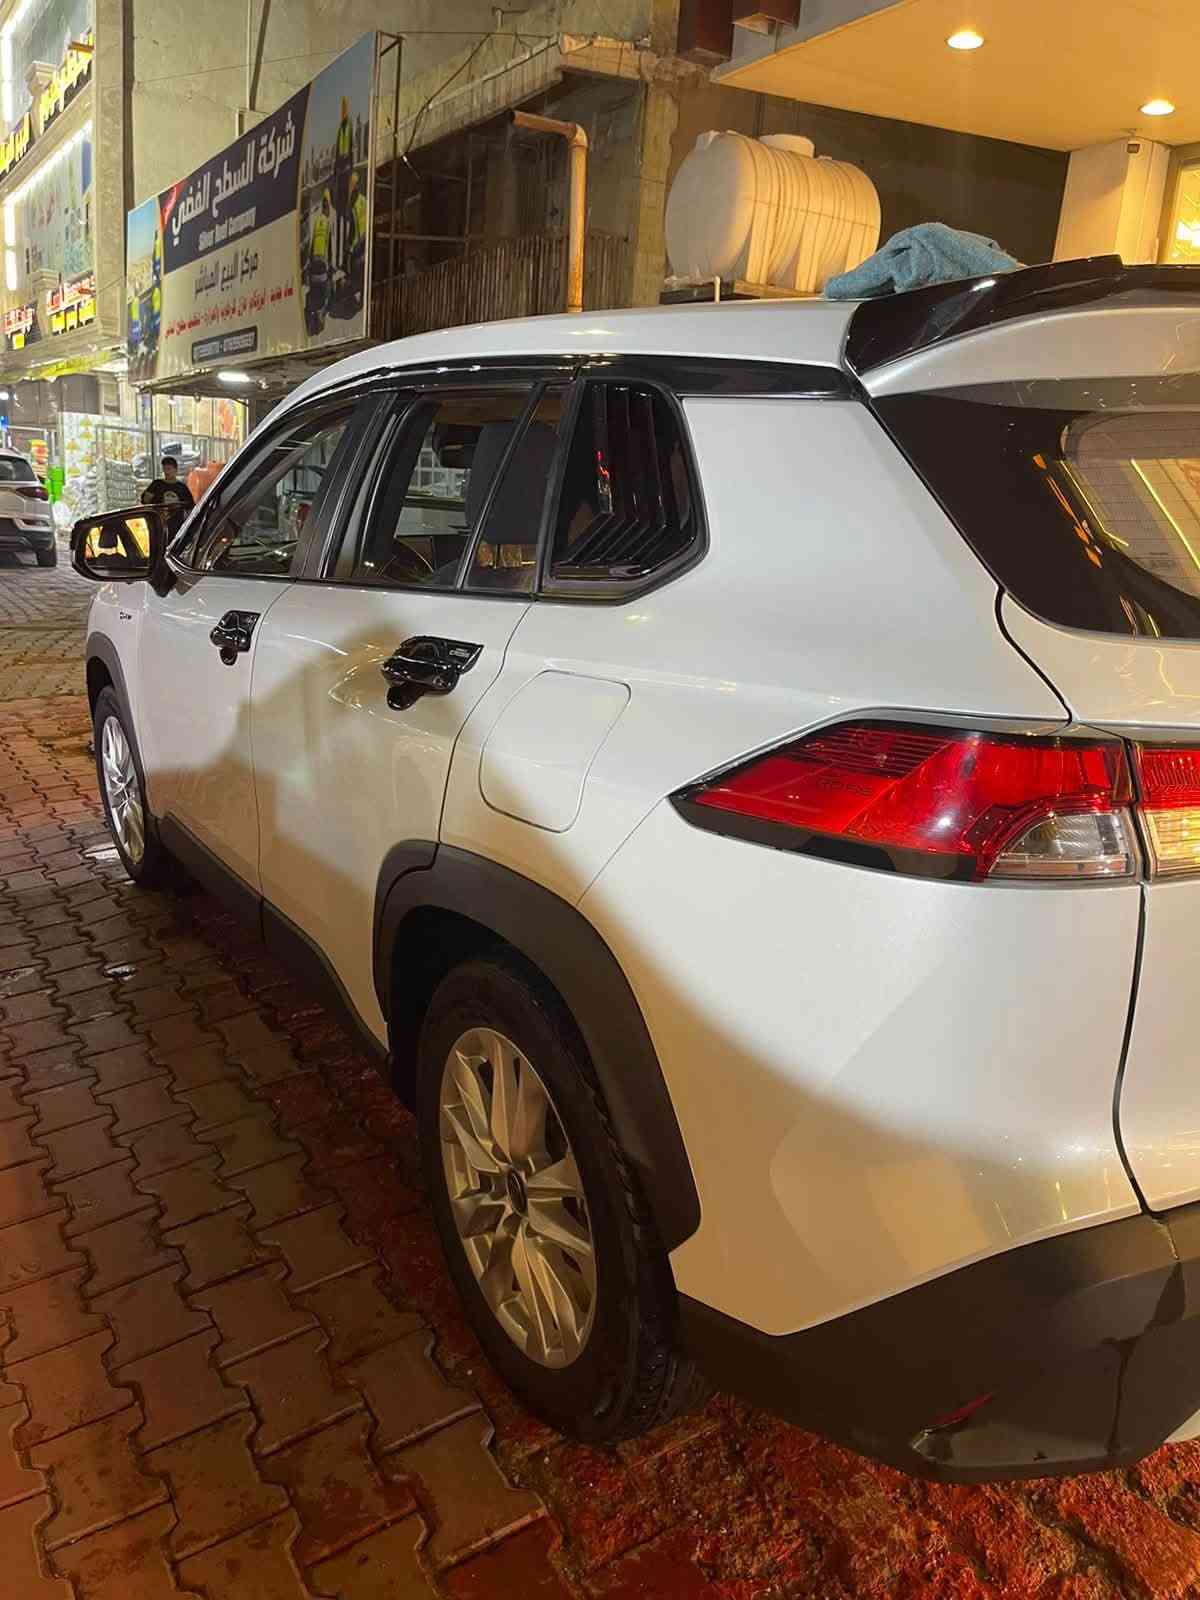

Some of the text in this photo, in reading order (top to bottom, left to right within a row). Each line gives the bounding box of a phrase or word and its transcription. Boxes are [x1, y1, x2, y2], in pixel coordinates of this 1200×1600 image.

[172, 111, 296, 247] شركة السطح الفضي
[194, 248, 258, 299] مركز البيع المباشر
